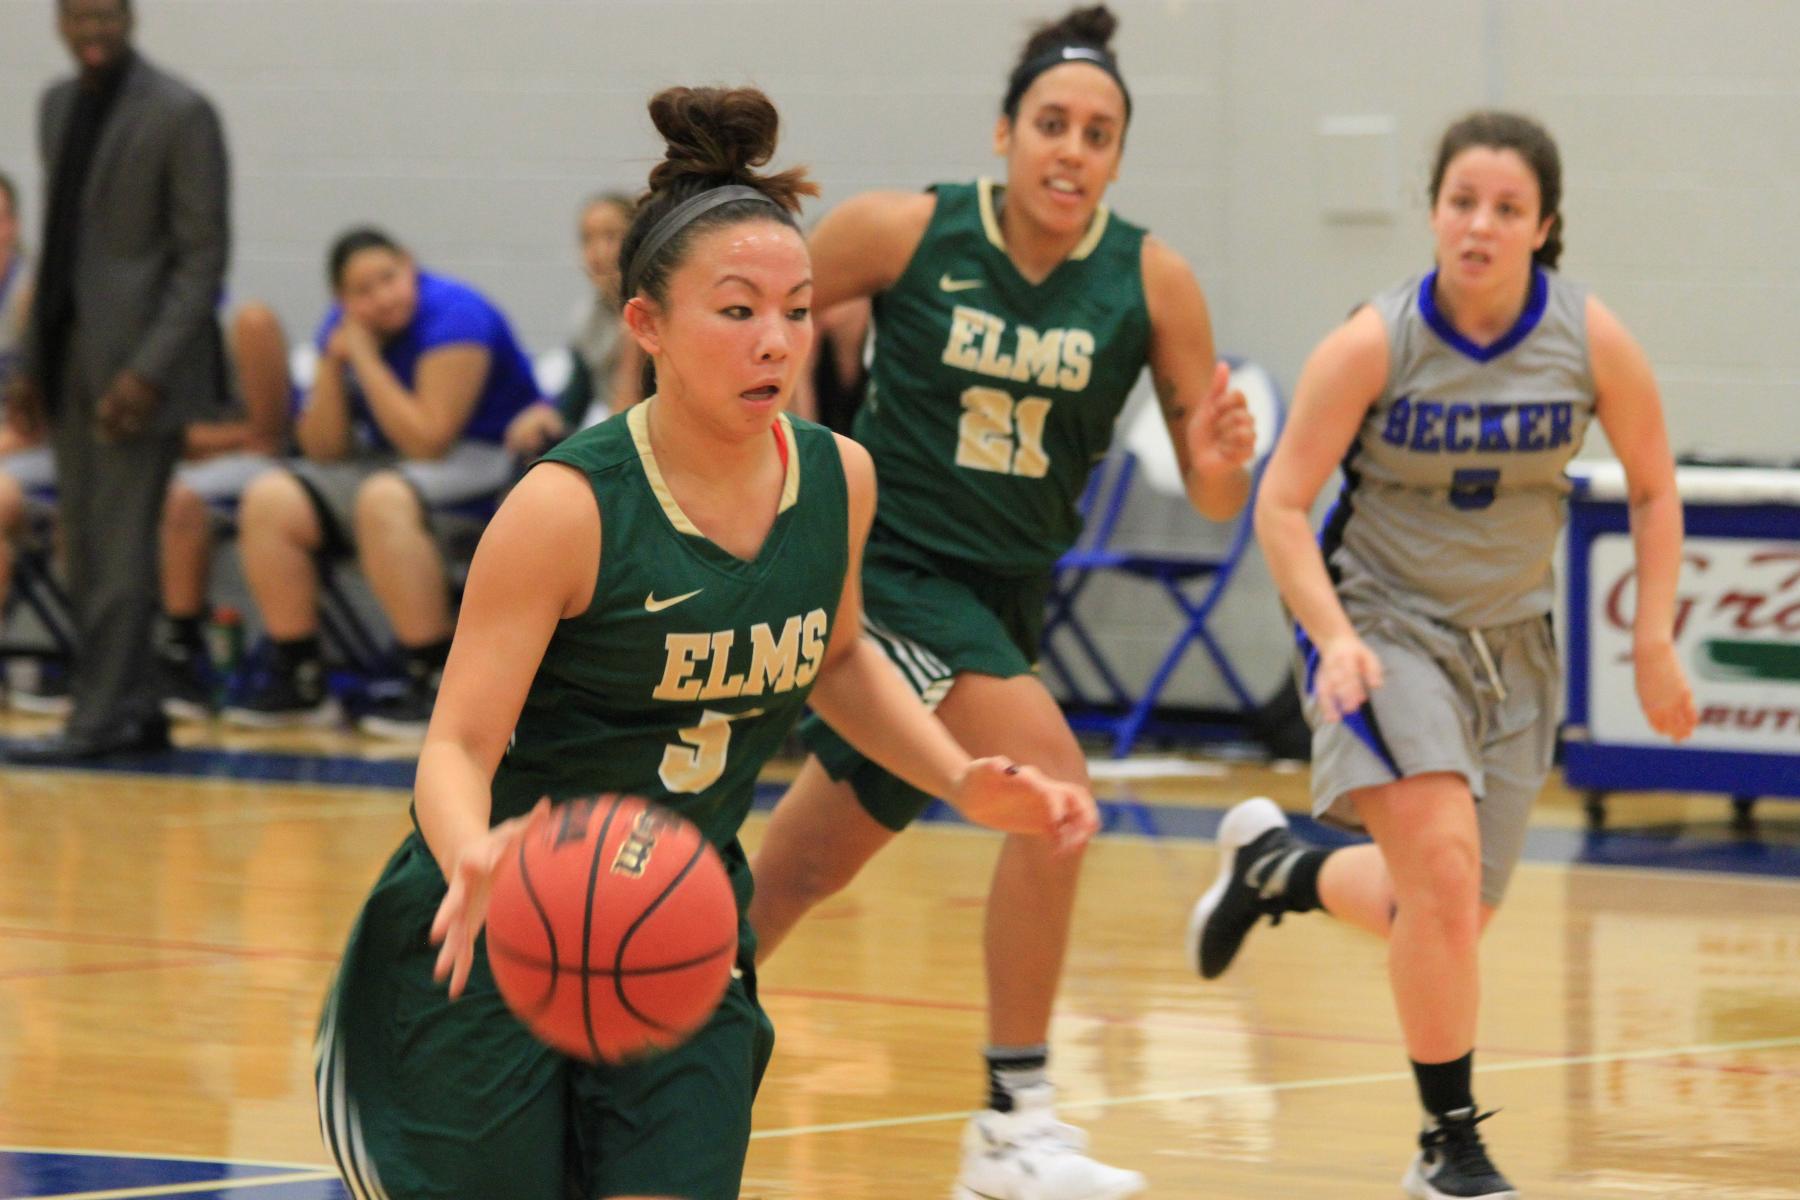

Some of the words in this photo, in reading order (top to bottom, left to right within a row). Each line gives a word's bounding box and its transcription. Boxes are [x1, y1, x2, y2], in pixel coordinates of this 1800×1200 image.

[942, 304, 1095, 392] ELMS
[955, 385, 1052, 478] 21
[1381, 395, 1572, 453] BECKER
[652, 607, 827, 701] ELMS
[657, 708, 765, 795] 5
